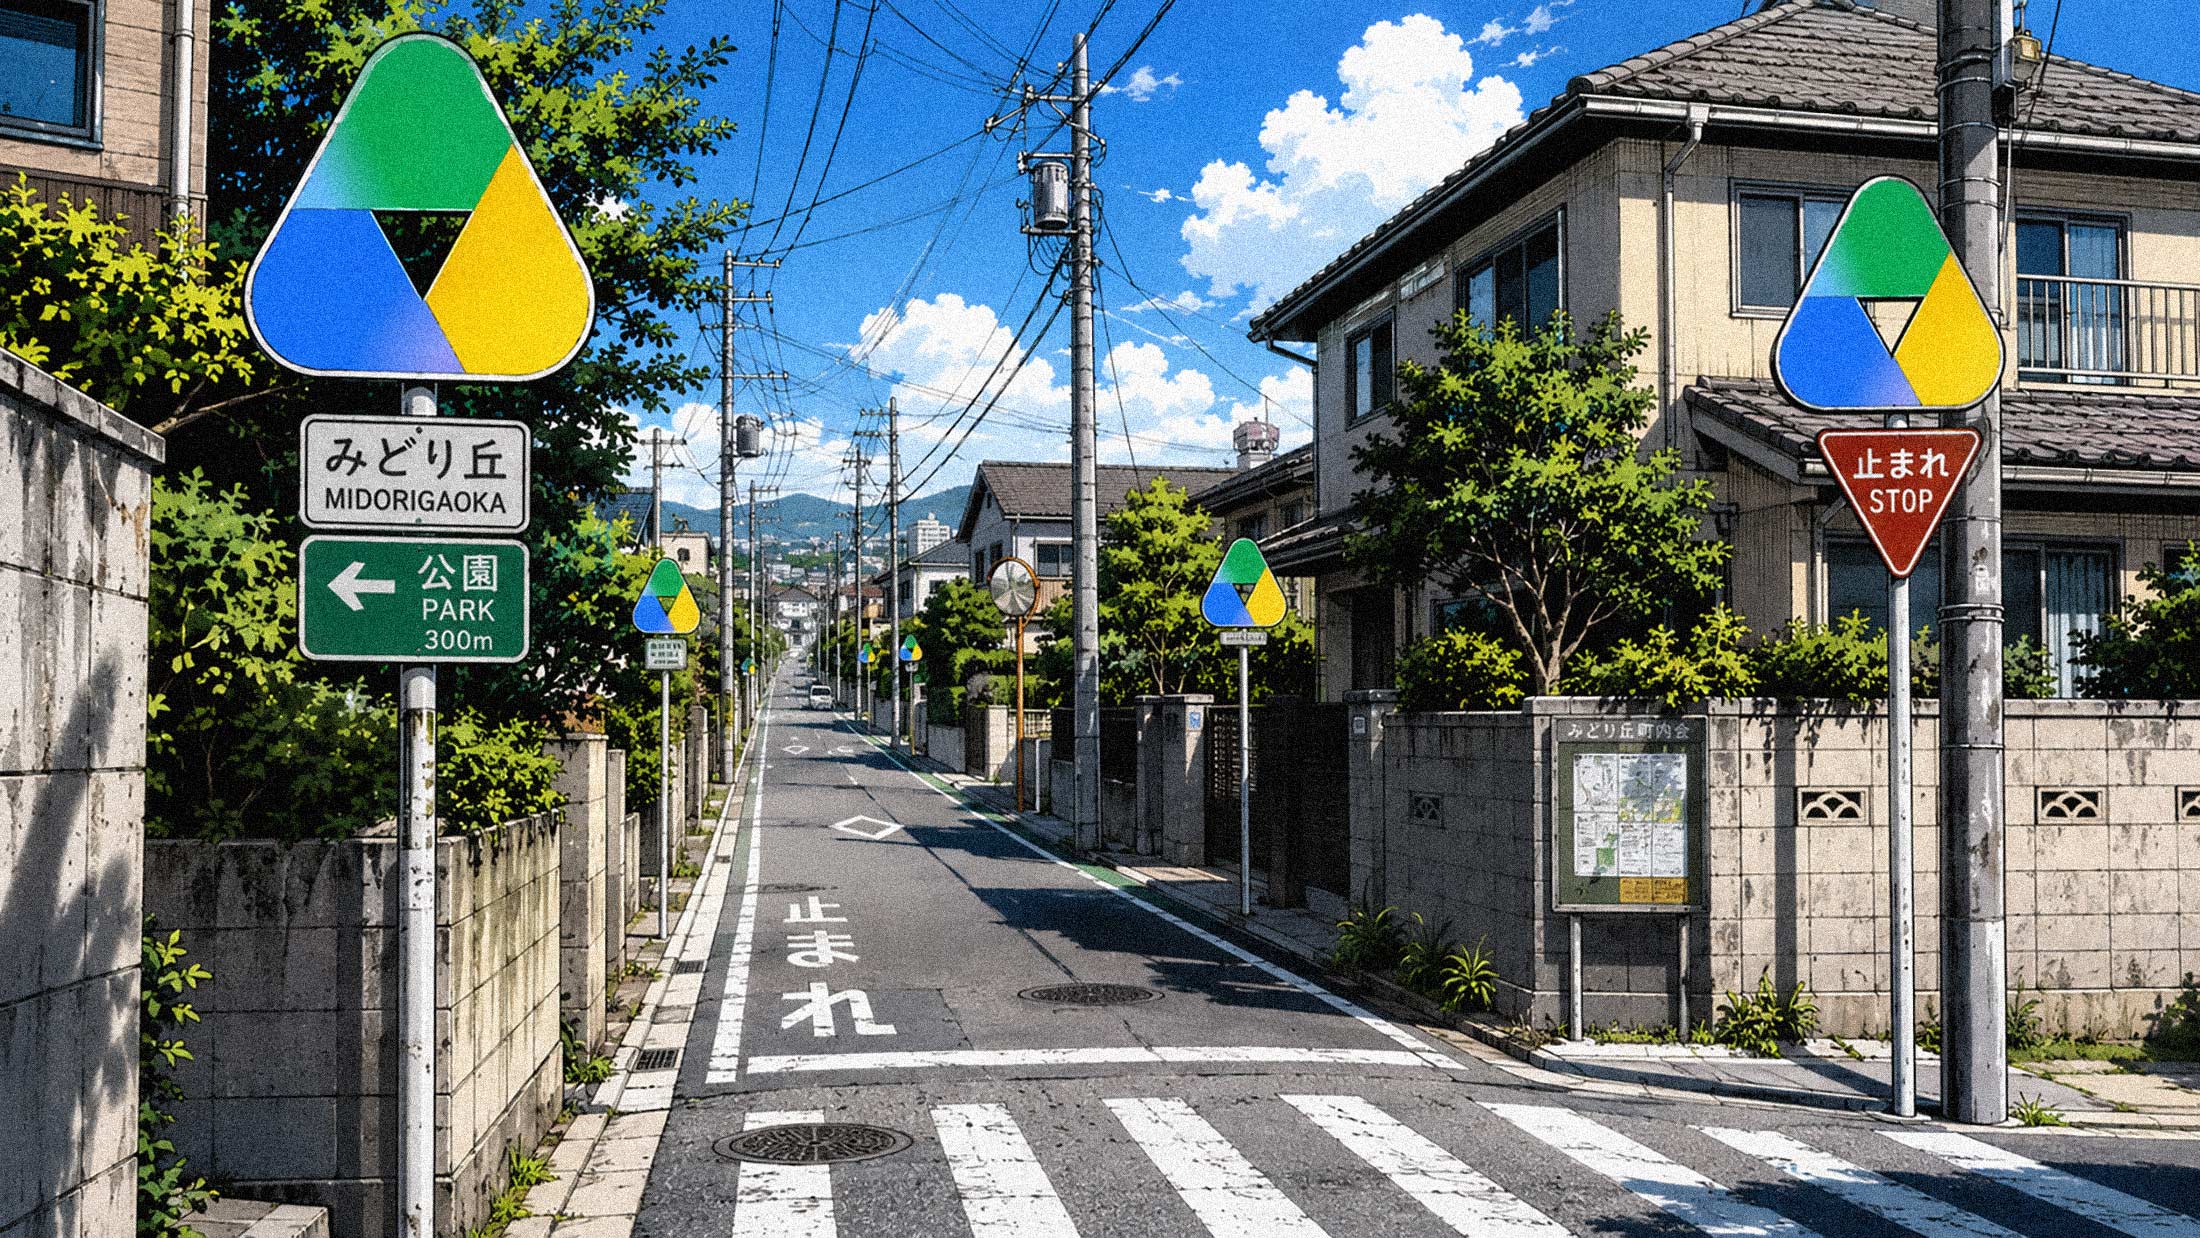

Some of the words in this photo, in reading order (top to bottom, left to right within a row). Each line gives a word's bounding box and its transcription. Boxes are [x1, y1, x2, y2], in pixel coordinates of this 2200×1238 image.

[325, 437, 507, 480] みどり丘
[1852, 448, 1949, 479] 止まれ
[325, 488, 506, 514] MIDORIGAOKA
[1869, 489, 1933, 514] STOP
[417, 553, 498, 593] 公園
[422, 599, 495, 622] PARK
[424, 630, 493, 651] 300m
[1567, 722, 1690, 739] みどり丘町内会
[780, 895, 898, 1037] 止まれ
